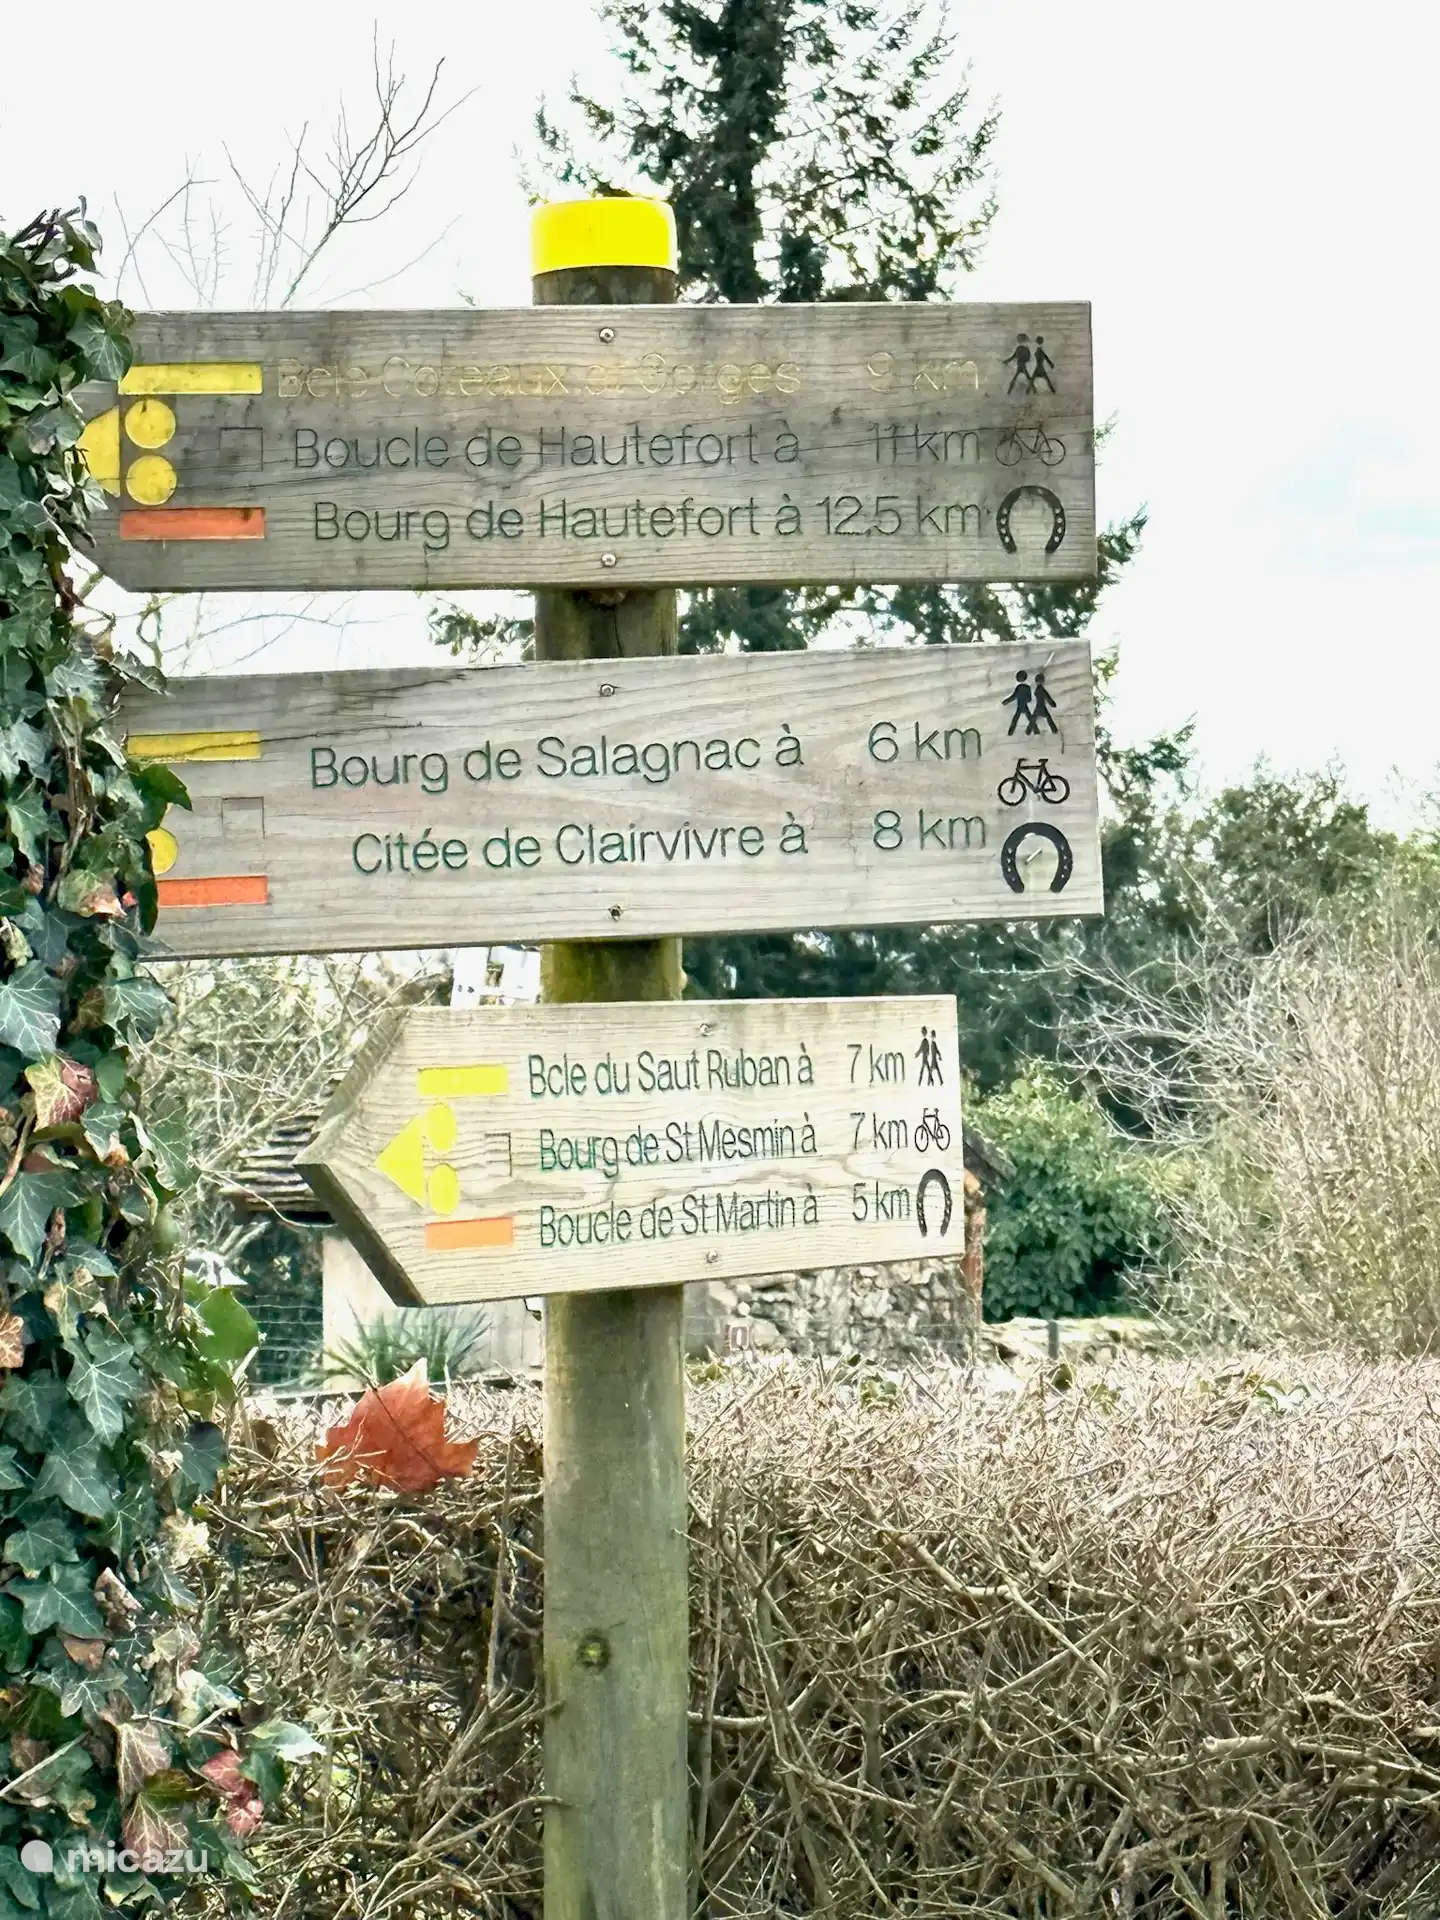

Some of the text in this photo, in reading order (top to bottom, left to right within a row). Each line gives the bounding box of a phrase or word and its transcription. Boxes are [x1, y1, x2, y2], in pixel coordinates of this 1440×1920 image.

[913, 351, 980, 391] km
[295, 419, 981, 469] Boucle de Hautefort à 11 km
[315, 501, 450, 551] Bourg
[466, 499, 524, 540] de
[540, 496, 760, 539] Hautefort
[774, 492, 803, 537] à
[916, 495, 982, 537] km
[311, 721, 982, 793] Bourg de Salagnac à 6 km
[352, 808, 986, 875] Citée de Clairvivre à 8 km
[528, 1042, 905, 1097] Bcle du Saut Ruban à 7 km
[540, 1112, 908, 1178] Bourg de St Mesmin à 7 km
[540, 1181, 911, 1247] Boucle de St Martin à 5 km
